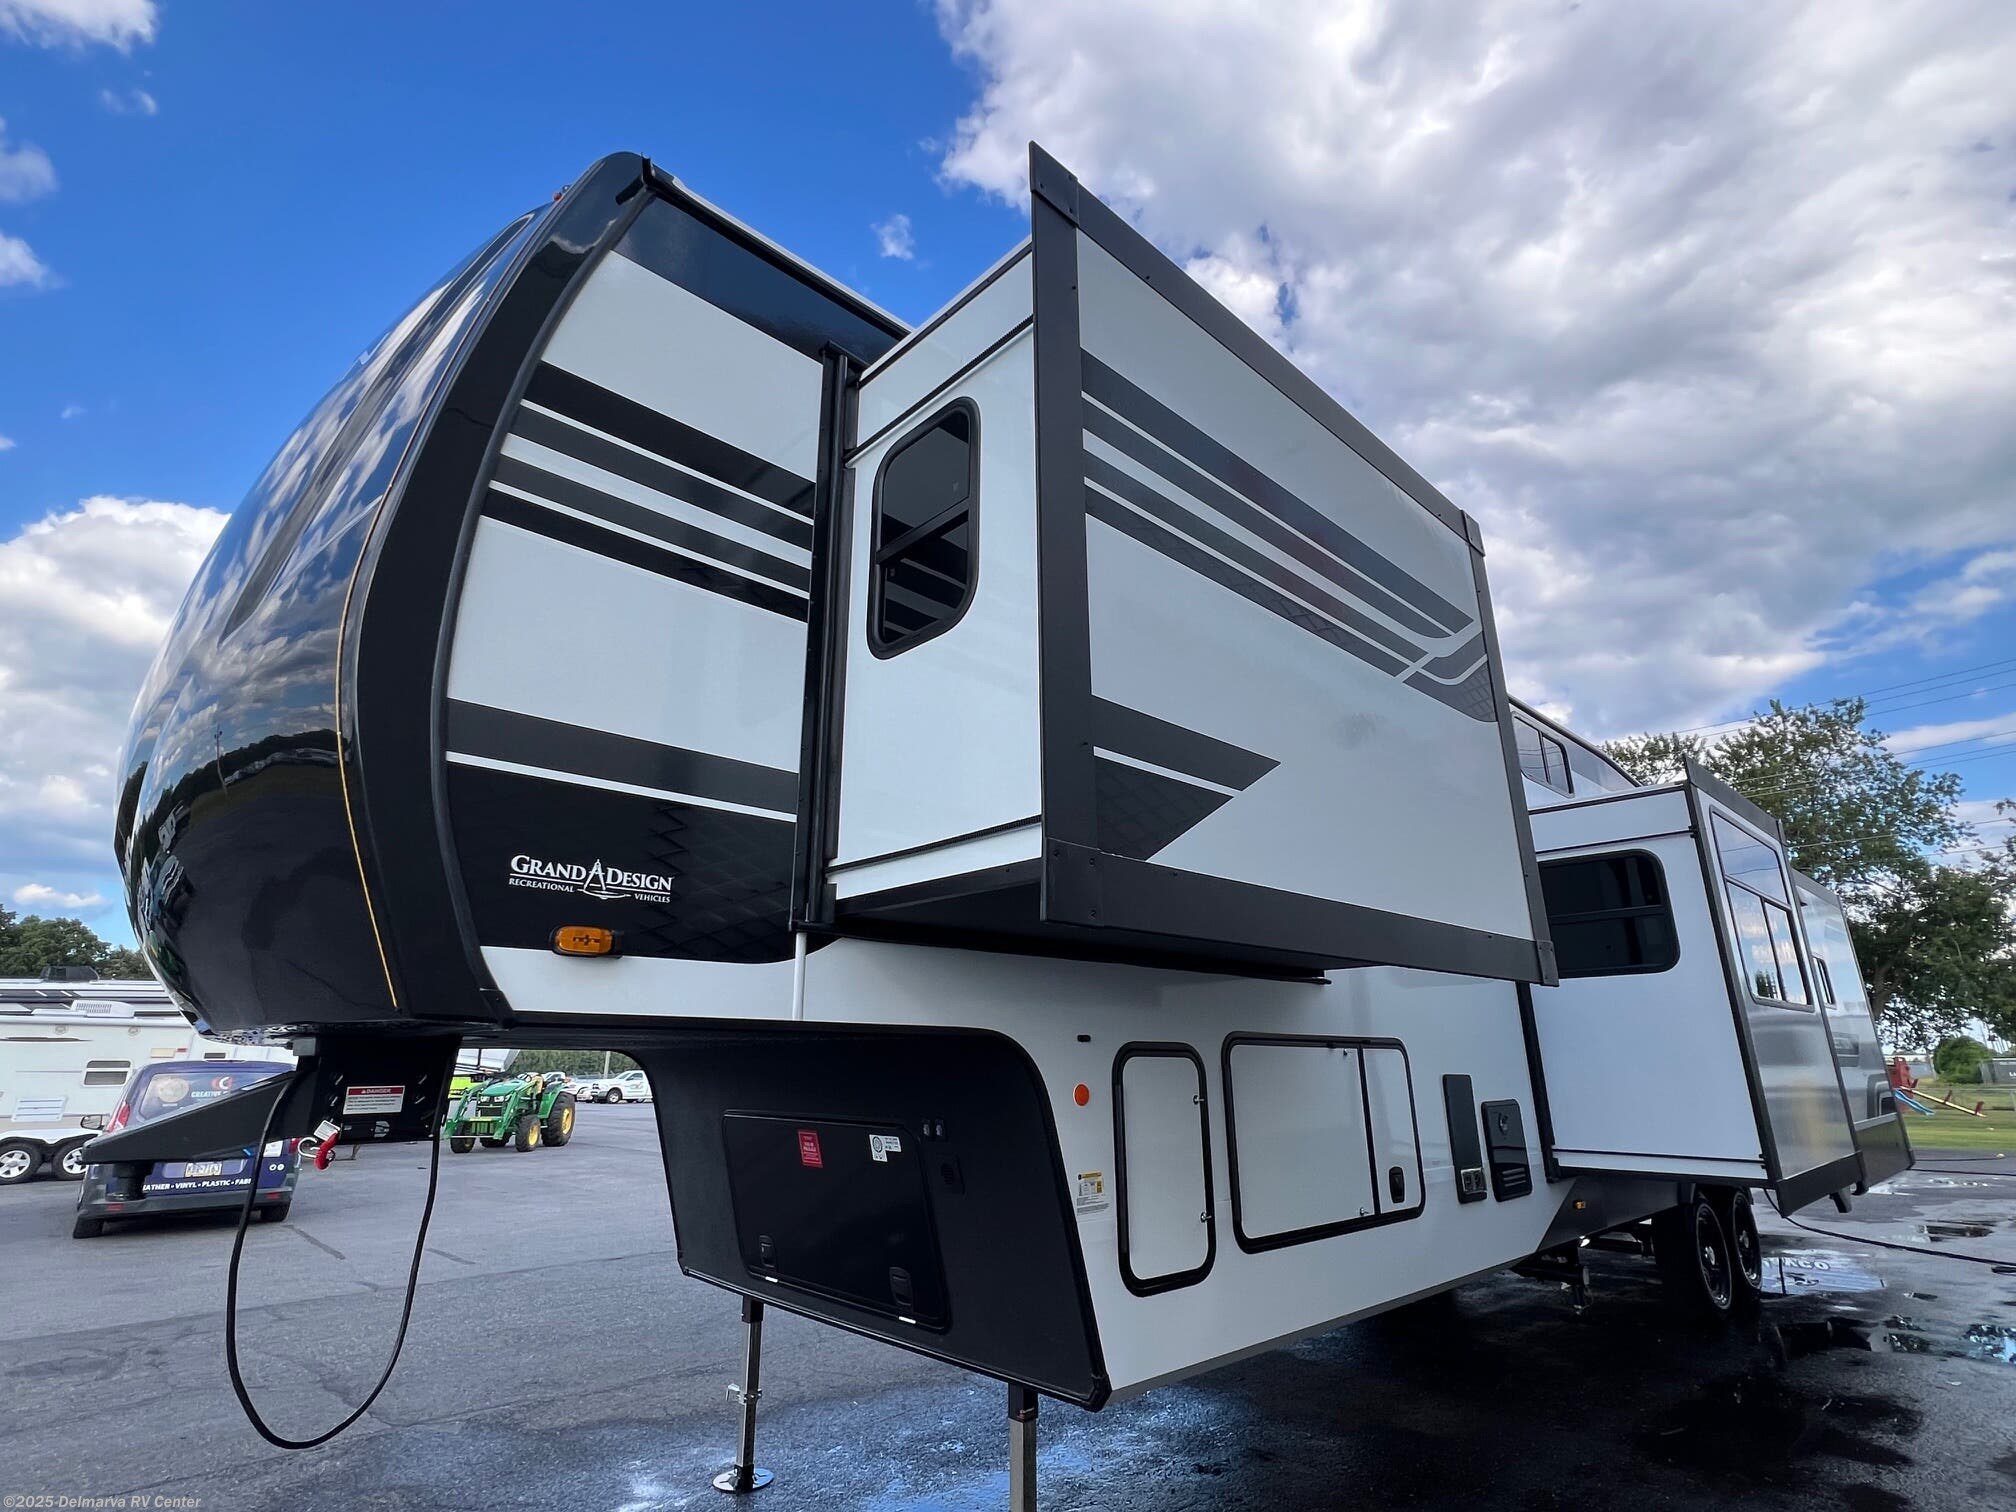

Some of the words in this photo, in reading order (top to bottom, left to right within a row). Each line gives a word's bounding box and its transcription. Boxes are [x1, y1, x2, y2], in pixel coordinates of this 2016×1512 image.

[510, 854, 587, 881] GRAND
[605, 867, 673, 891] DESIGN
[508, 878, 575, 893] RECREATIONAL
[634, 893, 671, 903] VEHICLES
[175, 1181, 198, 1189] VINYL
[202, 1179, 231, 1188] PLASTIC
